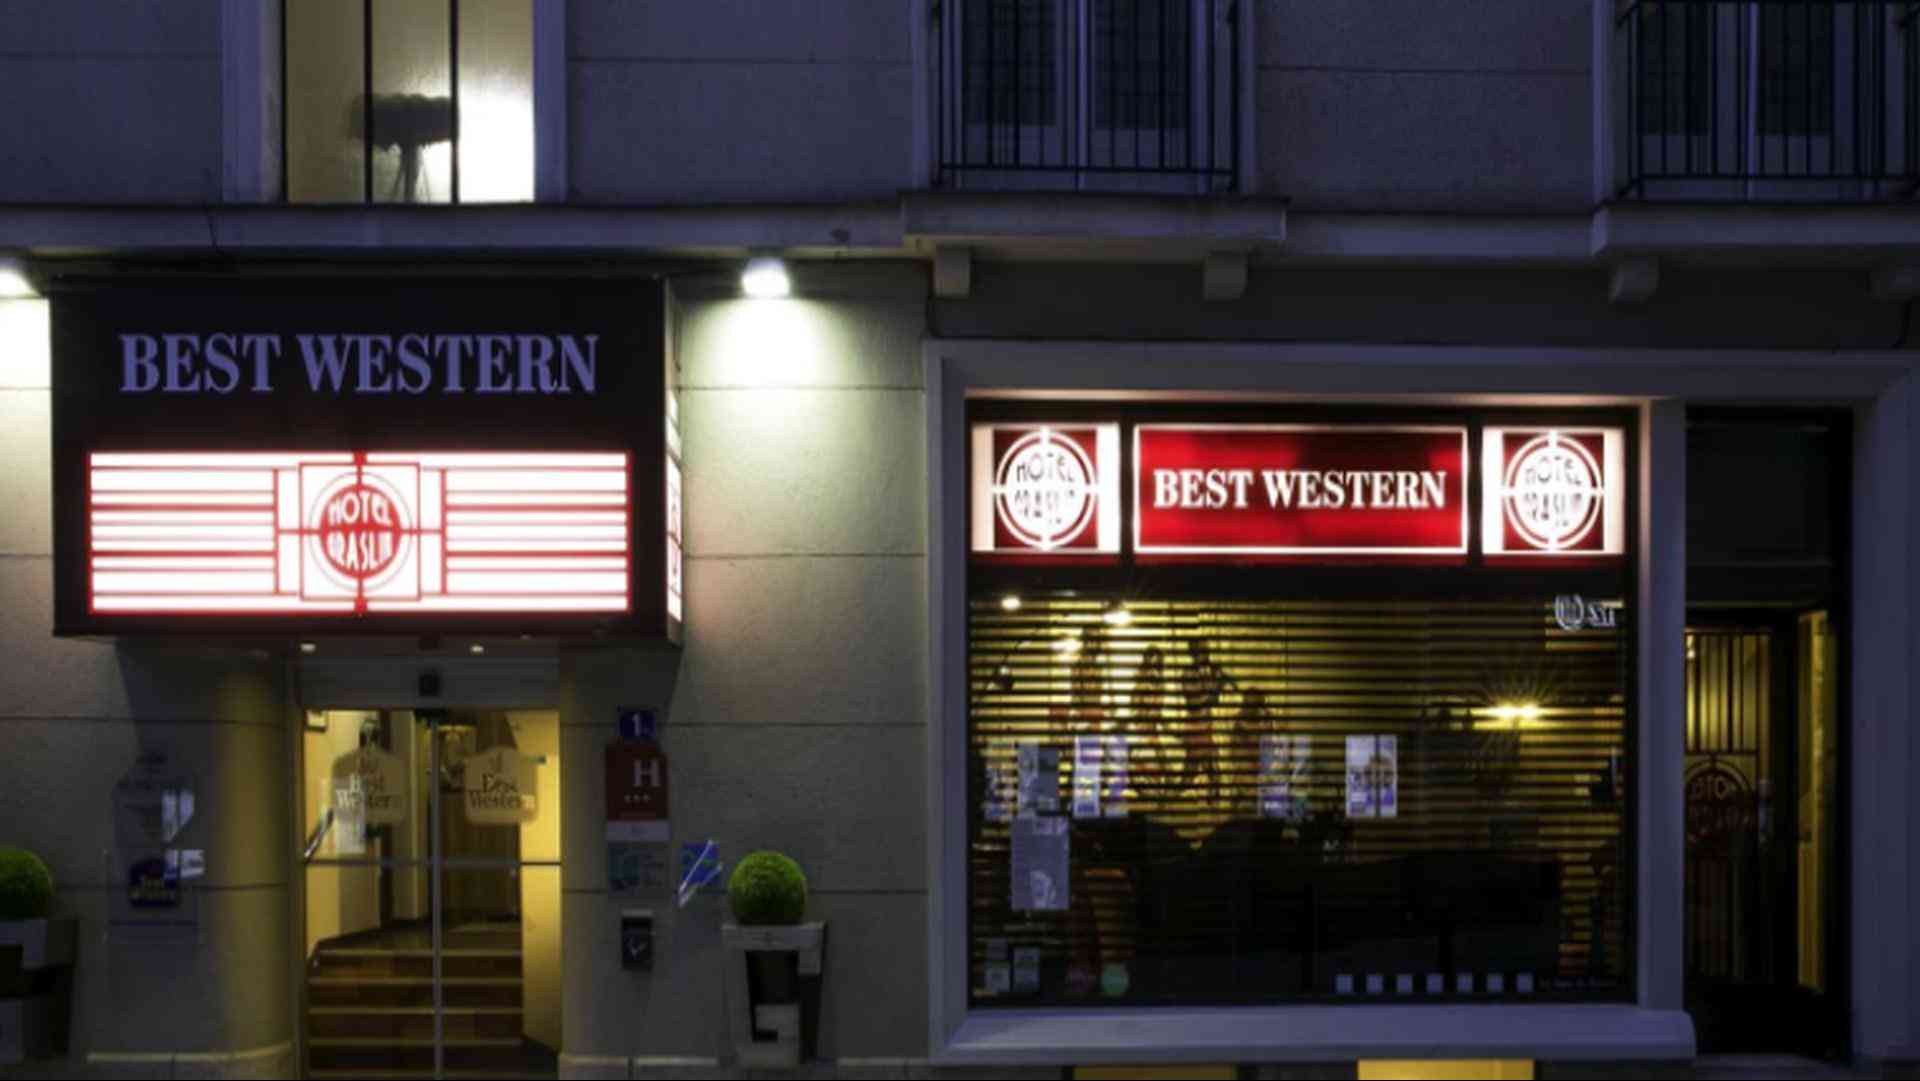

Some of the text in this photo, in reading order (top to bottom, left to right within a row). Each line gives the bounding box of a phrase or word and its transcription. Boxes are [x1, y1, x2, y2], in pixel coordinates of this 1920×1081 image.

[119, 331, 599, 394] BEST WESTERN
[1152, 468, 1448, 510] BEST WESTERN
[328, 490, 394, 526] HOTEL
[633, 758, 661, 788] H
[334, 789, 402, 810] Weter
[468, 790, 536, 810] Wester
